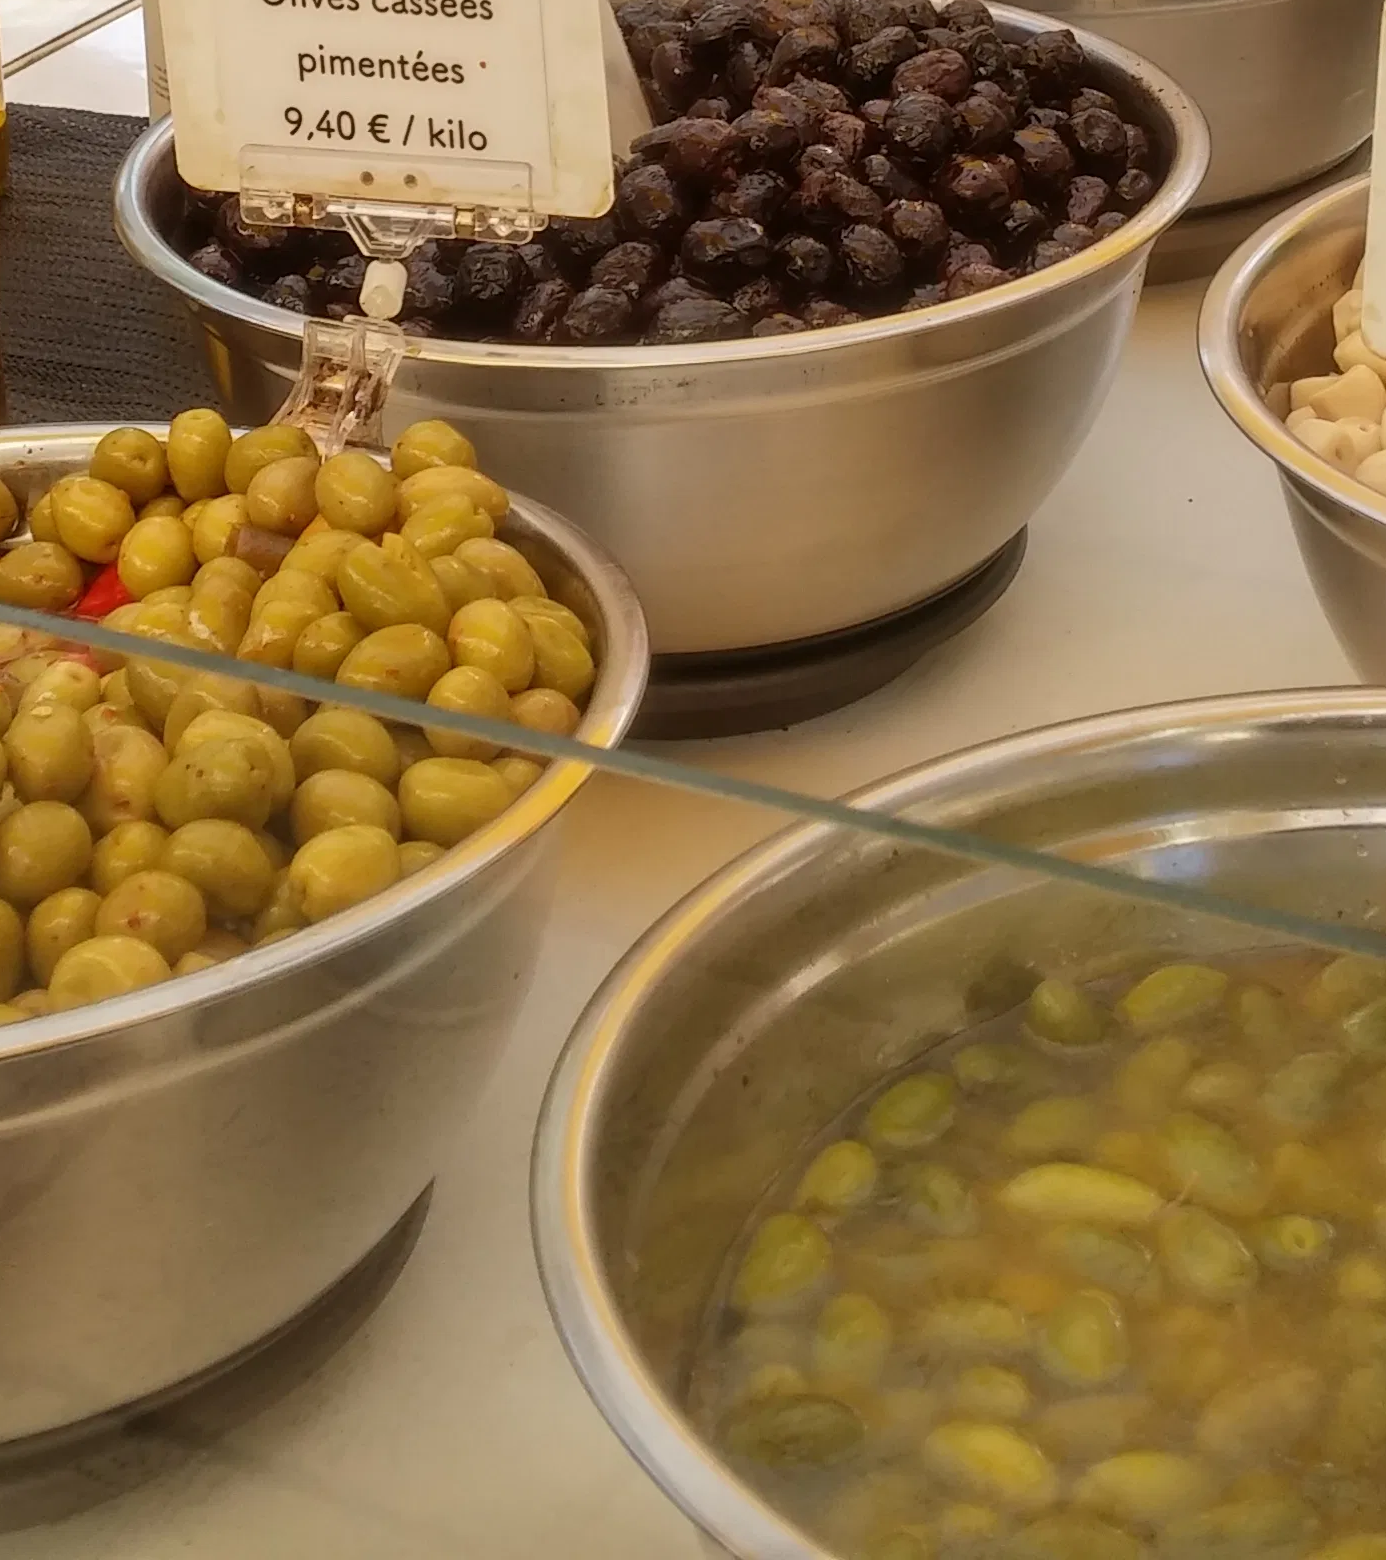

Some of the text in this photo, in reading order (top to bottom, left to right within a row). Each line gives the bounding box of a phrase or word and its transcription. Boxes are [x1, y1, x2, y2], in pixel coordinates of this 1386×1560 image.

[297, 44, 465, 85] pimentées
[283, 106, 488, 152] 9,40 € / kilo
